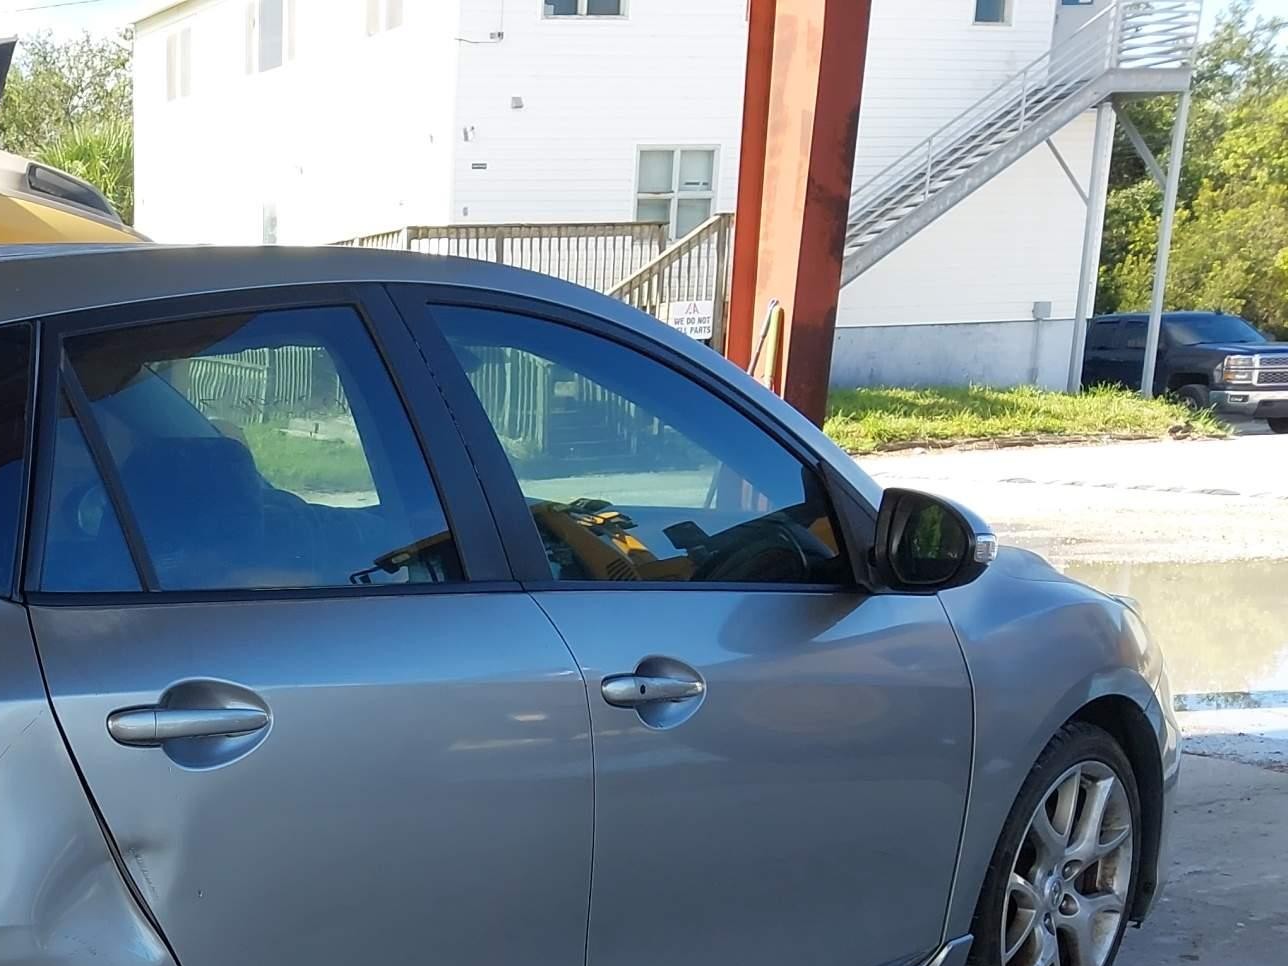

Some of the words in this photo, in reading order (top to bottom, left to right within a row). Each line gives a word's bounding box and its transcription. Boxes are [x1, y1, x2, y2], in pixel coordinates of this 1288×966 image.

[674, 317, 684, 325] WE
[686, 316, 696, 325] DO
[698, 315, 711, 324] NOT
[689, 326, 711, 335] PARTS
